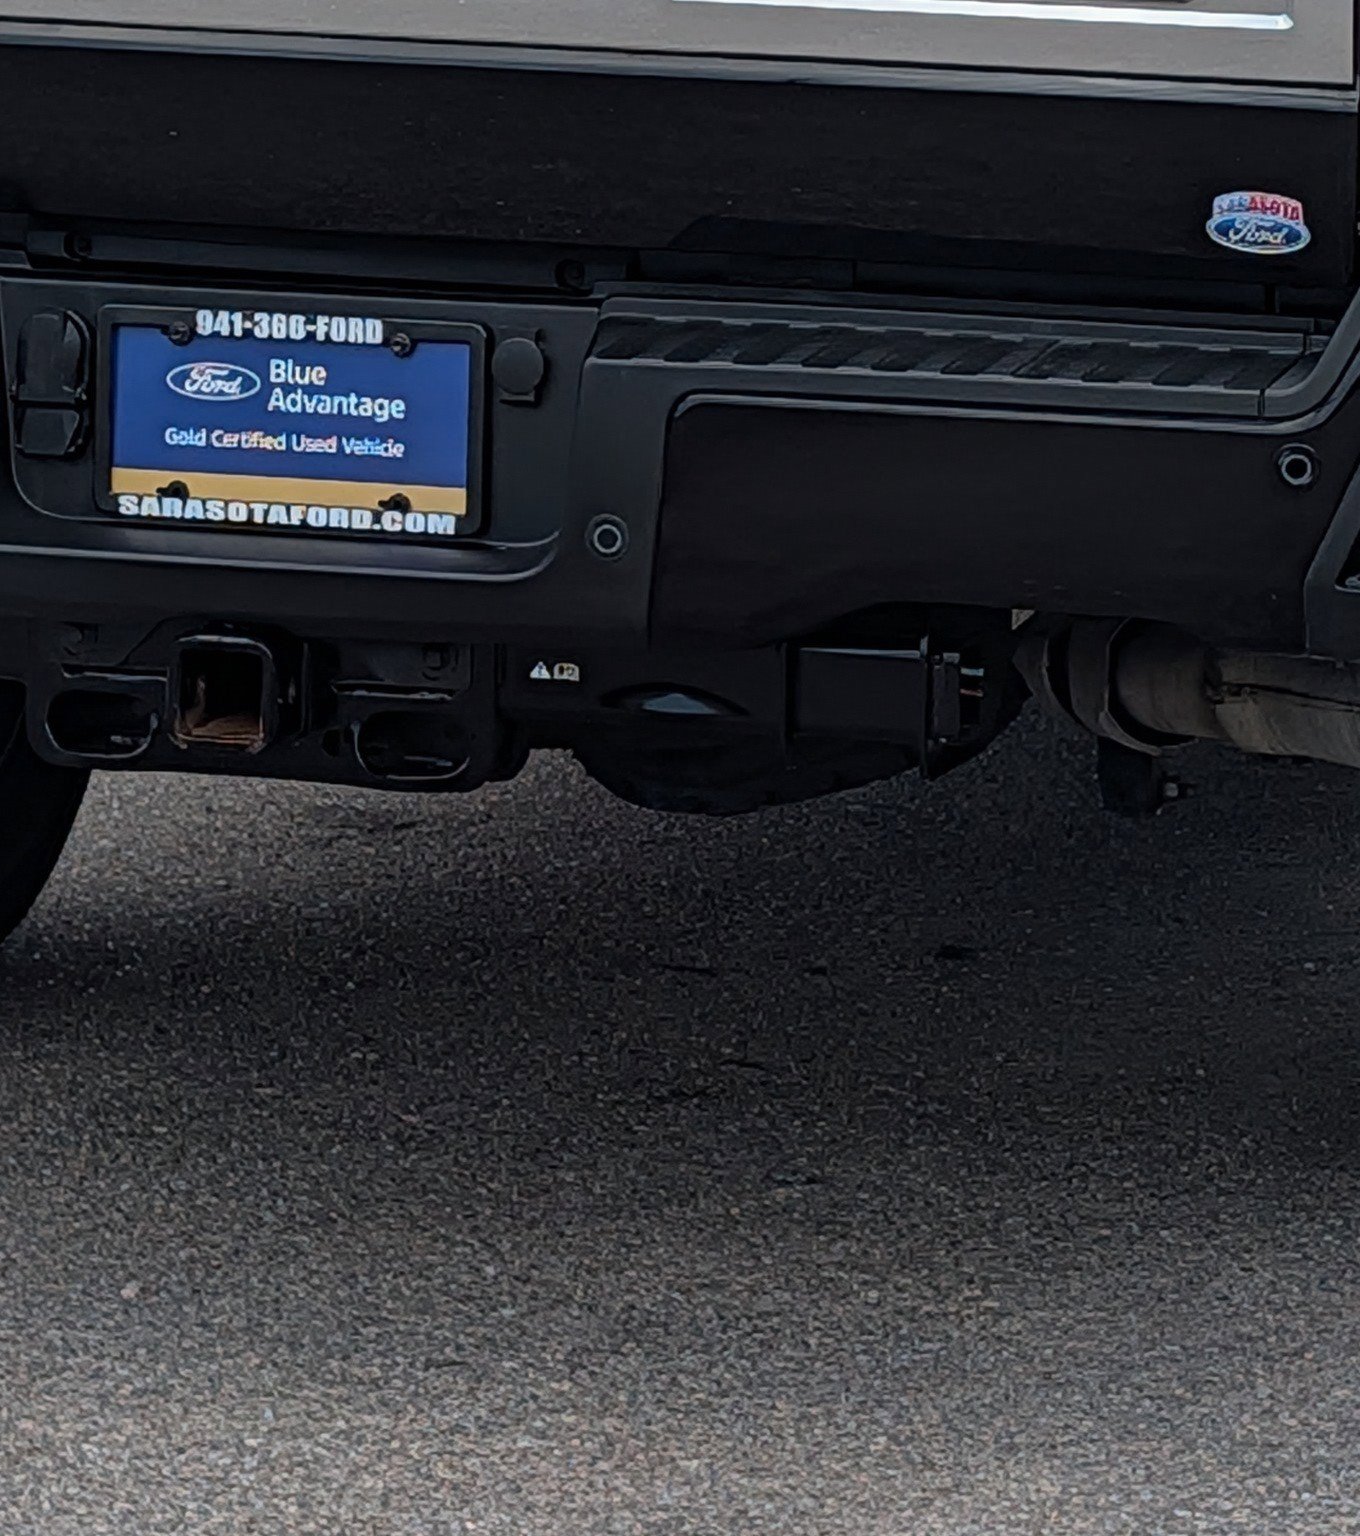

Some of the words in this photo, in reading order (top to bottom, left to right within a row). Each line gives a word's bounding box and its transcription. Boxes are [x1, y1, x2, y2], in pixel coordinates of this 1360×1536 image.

[1228, 216, 1290, 244] Ford
[184, 365, 243, 395] Ford
[269, 358, 327, 387] Blue
[267, 389, 407, 422] Advantage
[164, 426, 206, 447] Gold
[211, 429, 287, 451] Certified
[291, 433, 337, 454] Used
[342, 436, 406, 458] Vehicle
[118, 494, 457, 535] SARASOTAFORD.COM
